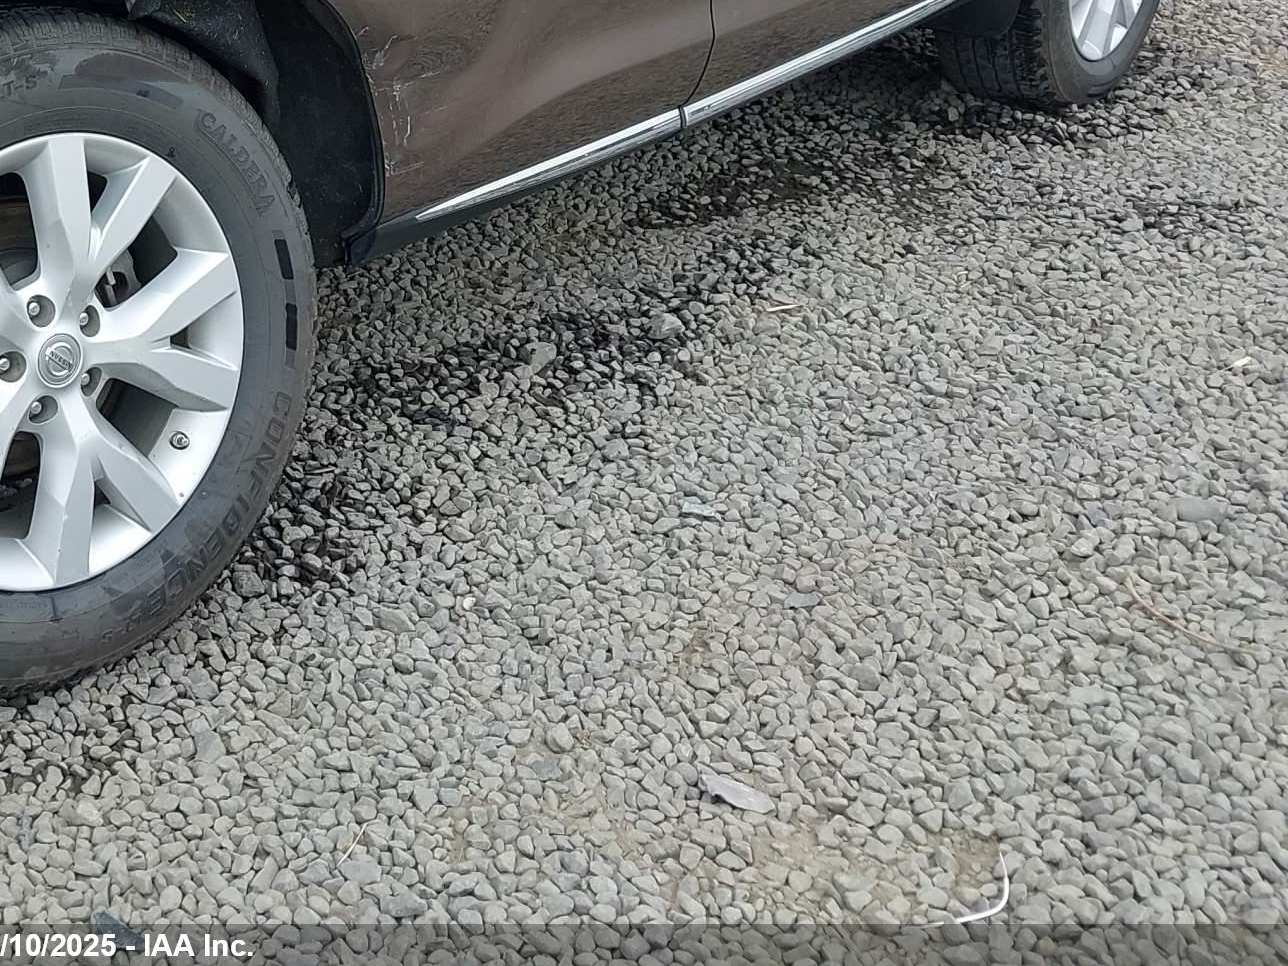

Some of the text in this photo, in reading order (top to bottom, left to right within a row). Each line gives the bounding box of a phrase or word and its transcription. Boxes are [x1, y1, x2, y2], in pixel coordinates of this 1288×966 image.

[200, 111, 276, 218] CALDERA
[49, 350, 74, 371] NISSAN
[145, 391, 292, 616] CONFIDENCE
